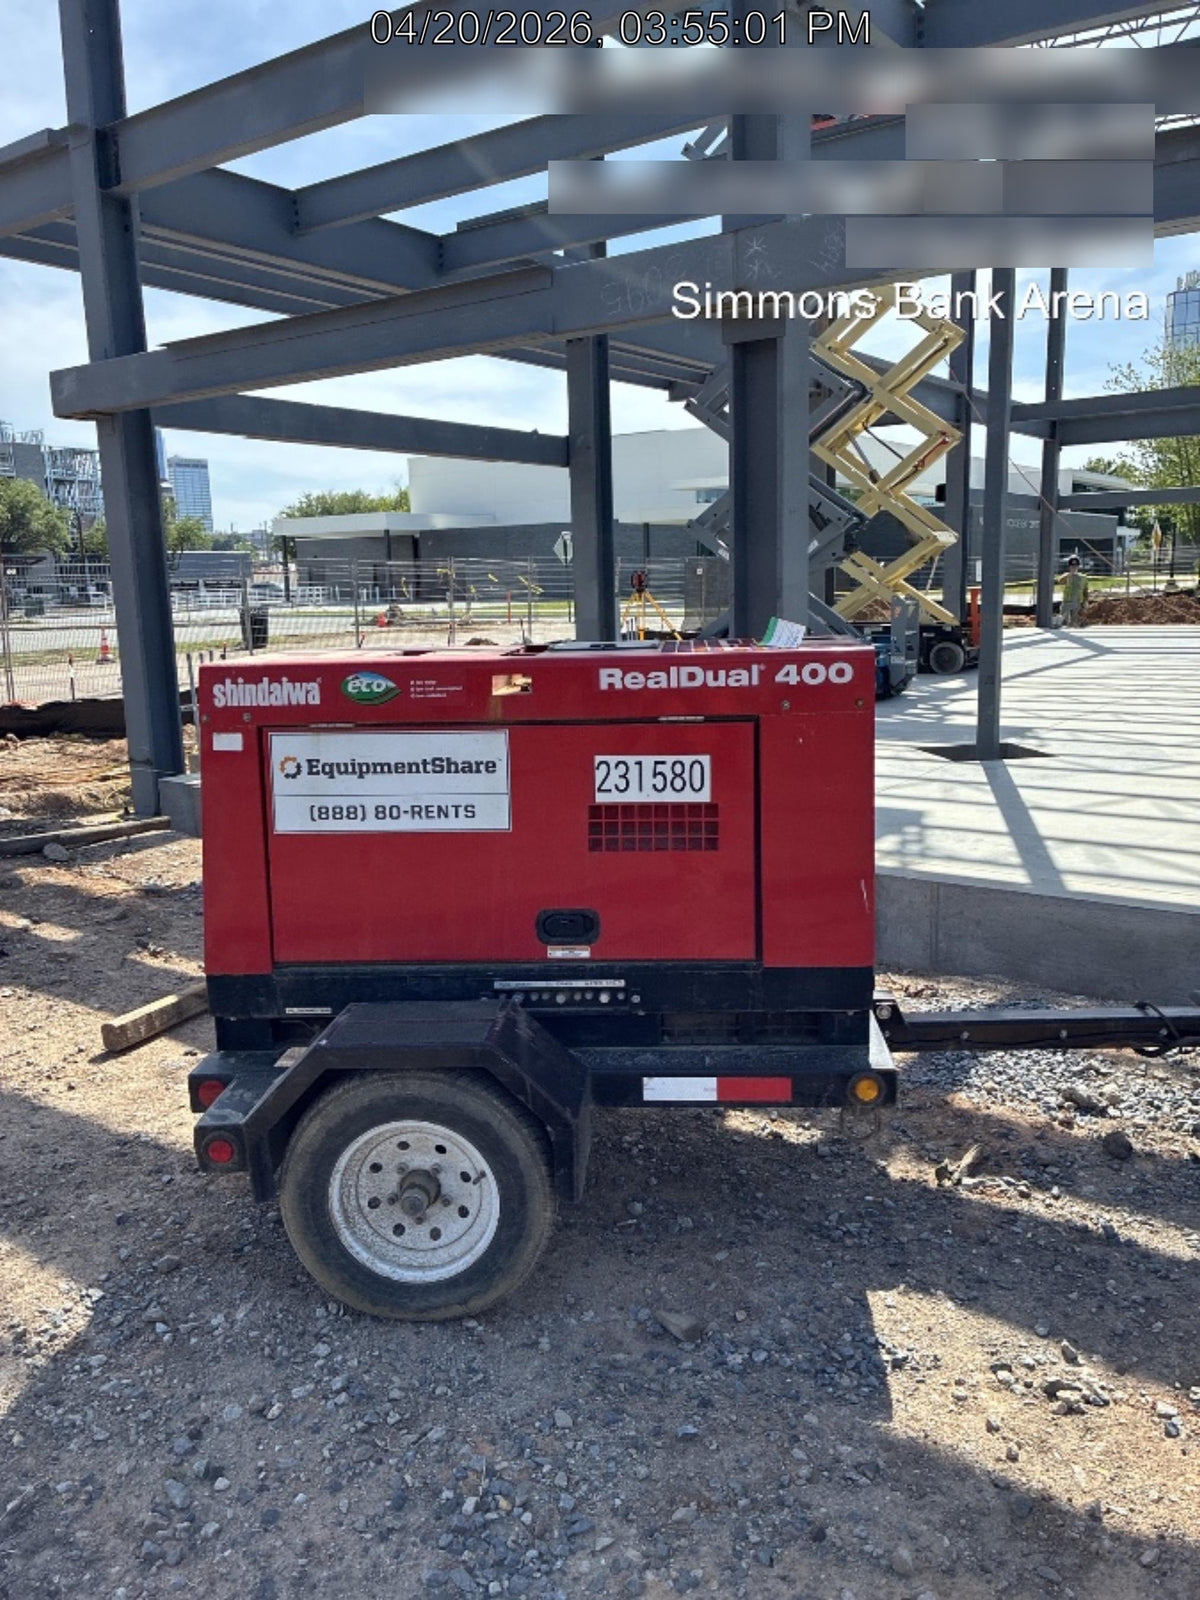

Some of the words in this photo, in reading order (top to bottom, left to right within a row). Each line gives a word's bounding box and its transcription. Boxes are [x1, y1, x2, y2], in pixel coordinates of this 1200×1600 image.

[599, 664, 760, 691] RealDual
[774, 662, 854, 686] 400
[212, 677, 321, 708] shindaiwa
[306, 757, 497, 779] EquipmentShare
[595, 759, 706, 793] 231580
[309, 805, 368, 822] (888)
[374, 804, 477, 820] 80-RENTS
